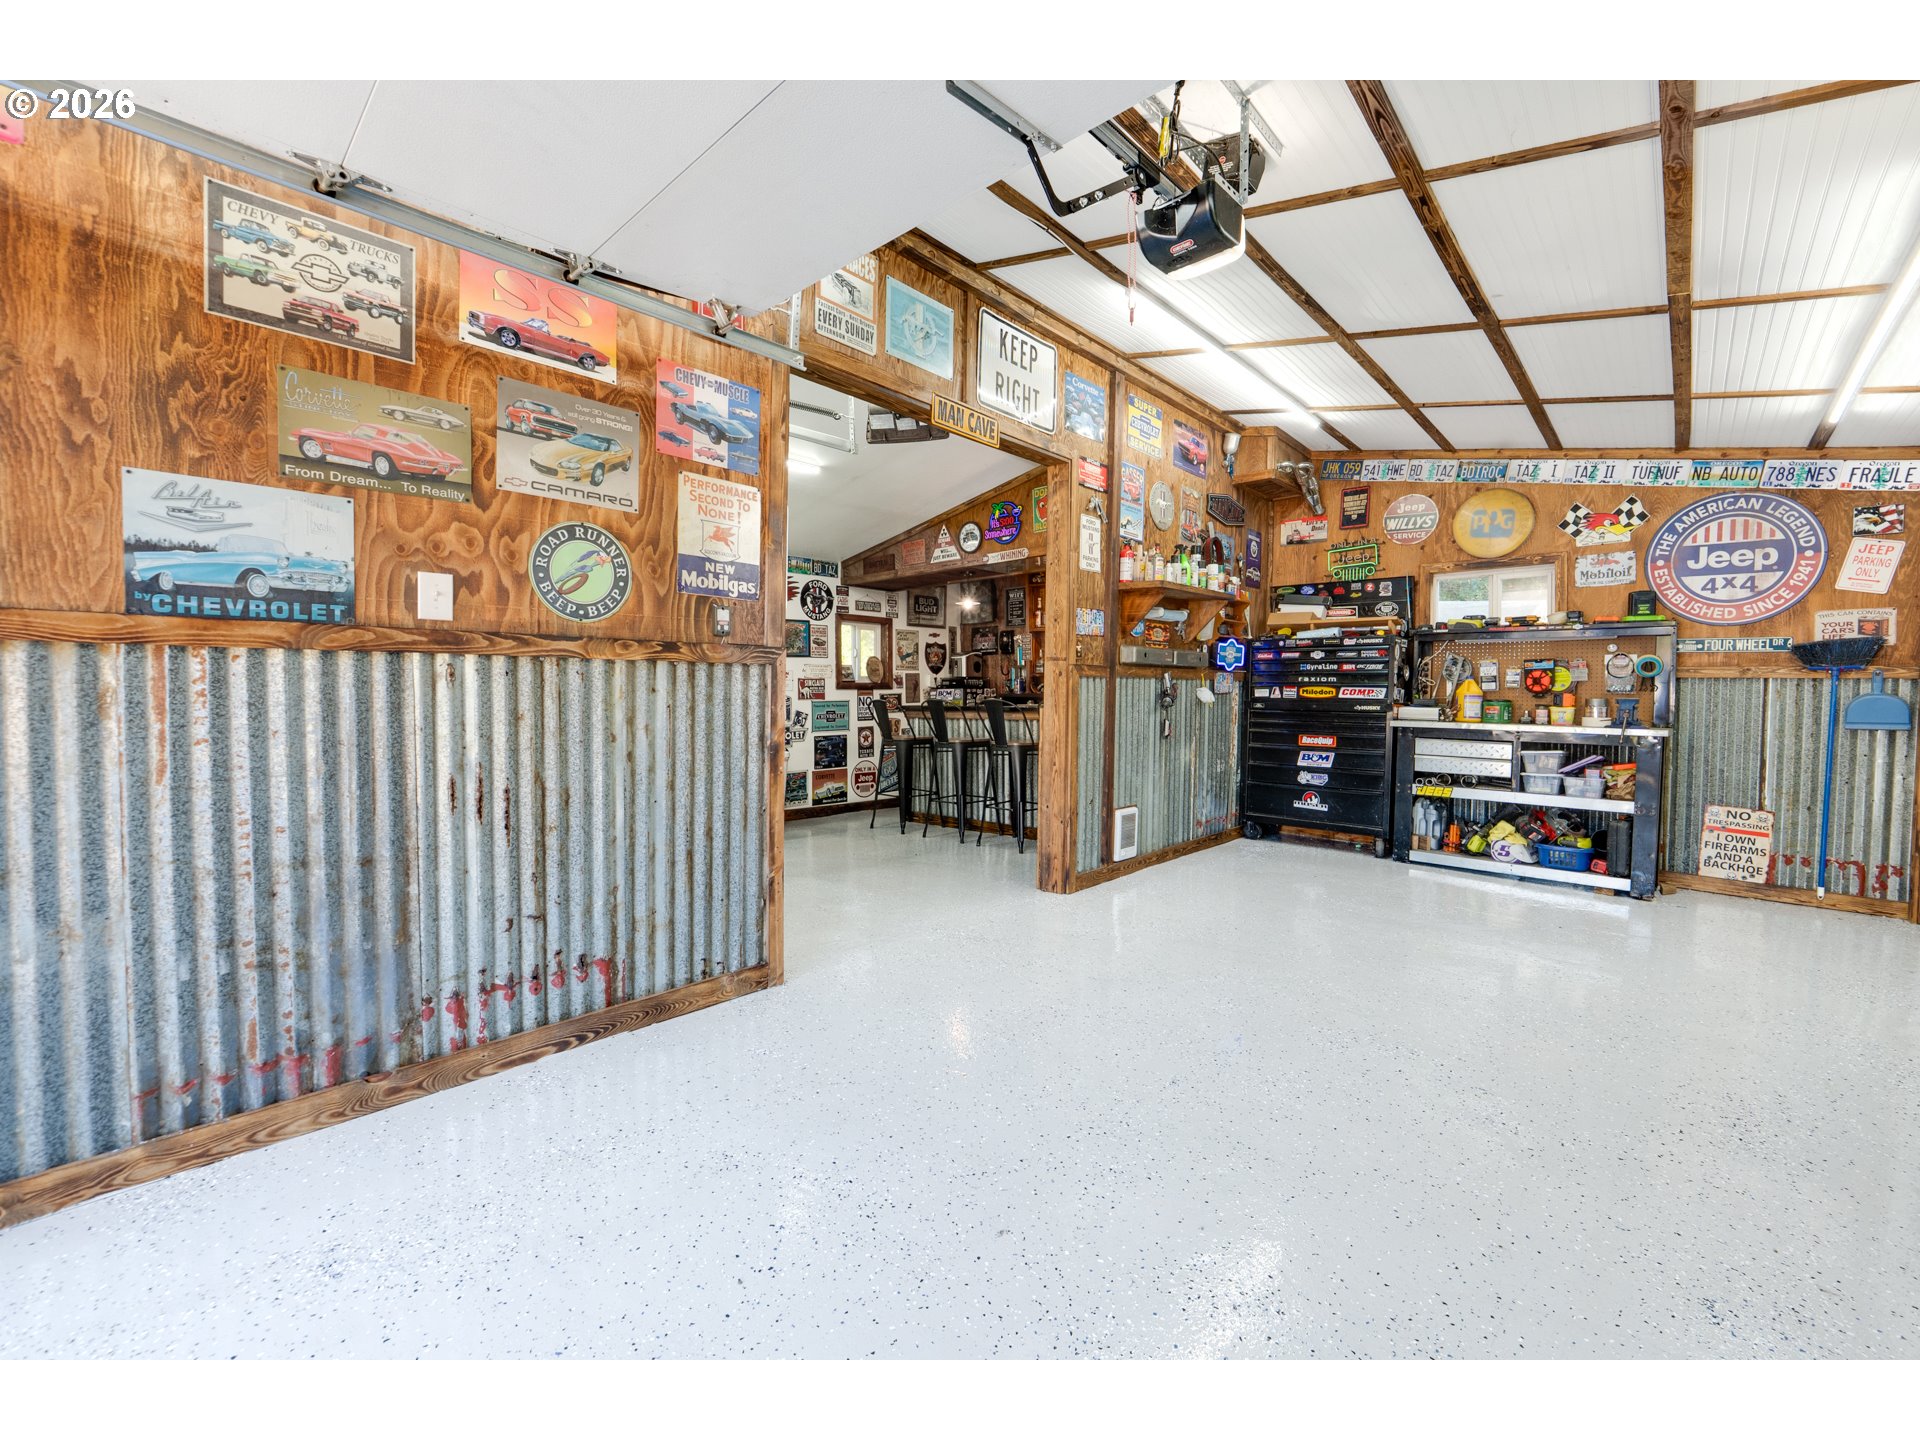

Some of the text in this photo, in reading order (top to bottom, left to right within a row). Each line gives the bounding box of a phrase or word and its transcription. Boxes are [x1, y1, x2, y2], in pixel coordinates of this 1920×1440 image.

[227, 200, 279, 225] CHEVY
[349, 239, 400, 265] TRUCKS
[818, 308, 843, 331] EVERY
[845, 320, 874, 345] SUNDAY
[818, 324, 845, 340] AFTERNOON
[999, 328, 1038, 373] KEEP
[285, 371, 357, 411] Corvette
[1072, 377, 1098, 396] Corvette
[995, 371, 1040, 418] RIGHT
[575, 404, 591, 414] Over
[592, 407, 602, 416] 30
[602, 410, 617, 420] Years
[1134, 398, 1157, 417] SUPER
[568, 411, 633, 432] still going STRONG!
[938, 400, 996, 440] MAN CAVE
[1131, 417, 1160, 438] CHEVROLET
[1130, 436, 1159, 457] SERVICE
[1323, 463, 1360, 474] JHK 059
[1364, 464, 1406, 476] 541 HWE
[1409, 465, 1455, 477] BD TAZ
[1516, 464, 1558, 477] TAZ I
[1574, 465, 1616, 478] TAZ II
[1632, 466, 1683, 480] TUFNUF
[1692, 467, 1758, 480] NB AUTO
[1768, 467, 1837, 482] 788 NES
[285, 464, 465, 502] From Dream... To Reality
[683, 475, 758, 502] PERFORMANCE
[531, 480, 633, 507] CAMARO
[689, 489, 751, 512] SECOND TO
[1397, 503, 1427, 514] Jeep
[1386, 515, 1435, 531] WILLYS
[1655, 498, 1816, 557] THE AMERICAN LEGEND
[984, 527, 1017, 540] Somewhere
[1392, 532, 1427, 540] SERVICE
[535, 526, 627, 578] ROAD RUNNER
[1000, 549, 1026, 560] WHINING
[1858, 543, 1895, 555] JEEP
[1337, 553, 1370, 564] Jeep
[1687, 547, 1778, 570] Jeep
[1852, 555, 1892, 568] PARKING
[705, 561, 735, 575] NEW
[1580, 565, 1632, 582] Mobiloil
[1855, 567, 1880, 578] ONLY
[681, 569, 756, 598] Mobilgas
[809, 581, 828, 591] FORD
[1654, 559, 1816, 619] ESTABLISHED SINCE 1941
[539, 580, 622, 617] BEEP BEEP
[134, 590, 347, 622] by CHEVROLET
[803, 605, 831, 620] MUSTANG
[915, 605, 937, 614] LIGHT
[1857, 609, 1894, 617] CONTAINS
[1704, 639, 1734, 651] FOUR
[1735, 639, 1774, 650] WHEEL
[1306, 663, 1338, 671] Gyraline
[1341, 688, 1375, 696] COMP
[858, 697, 872, 707] NO
[1302, 736, 1334, 745] RaceQuip
[1301, 754, 1331, 762] B&M
[858, 774, 874, 782] Jeep
[1416, 785, 1453, 798] JEGS
[1726, 810, 1752, 821] NO
[1707, 818, 1770, 831] TRESPASSING
[1716, 833, 1757, 846] I OWN
[1704, 841, 1767, 857] FIREARMS
[1714, 851, 1754, 864] AND A
[1703, 858, 1764, 875] BACKHOE
